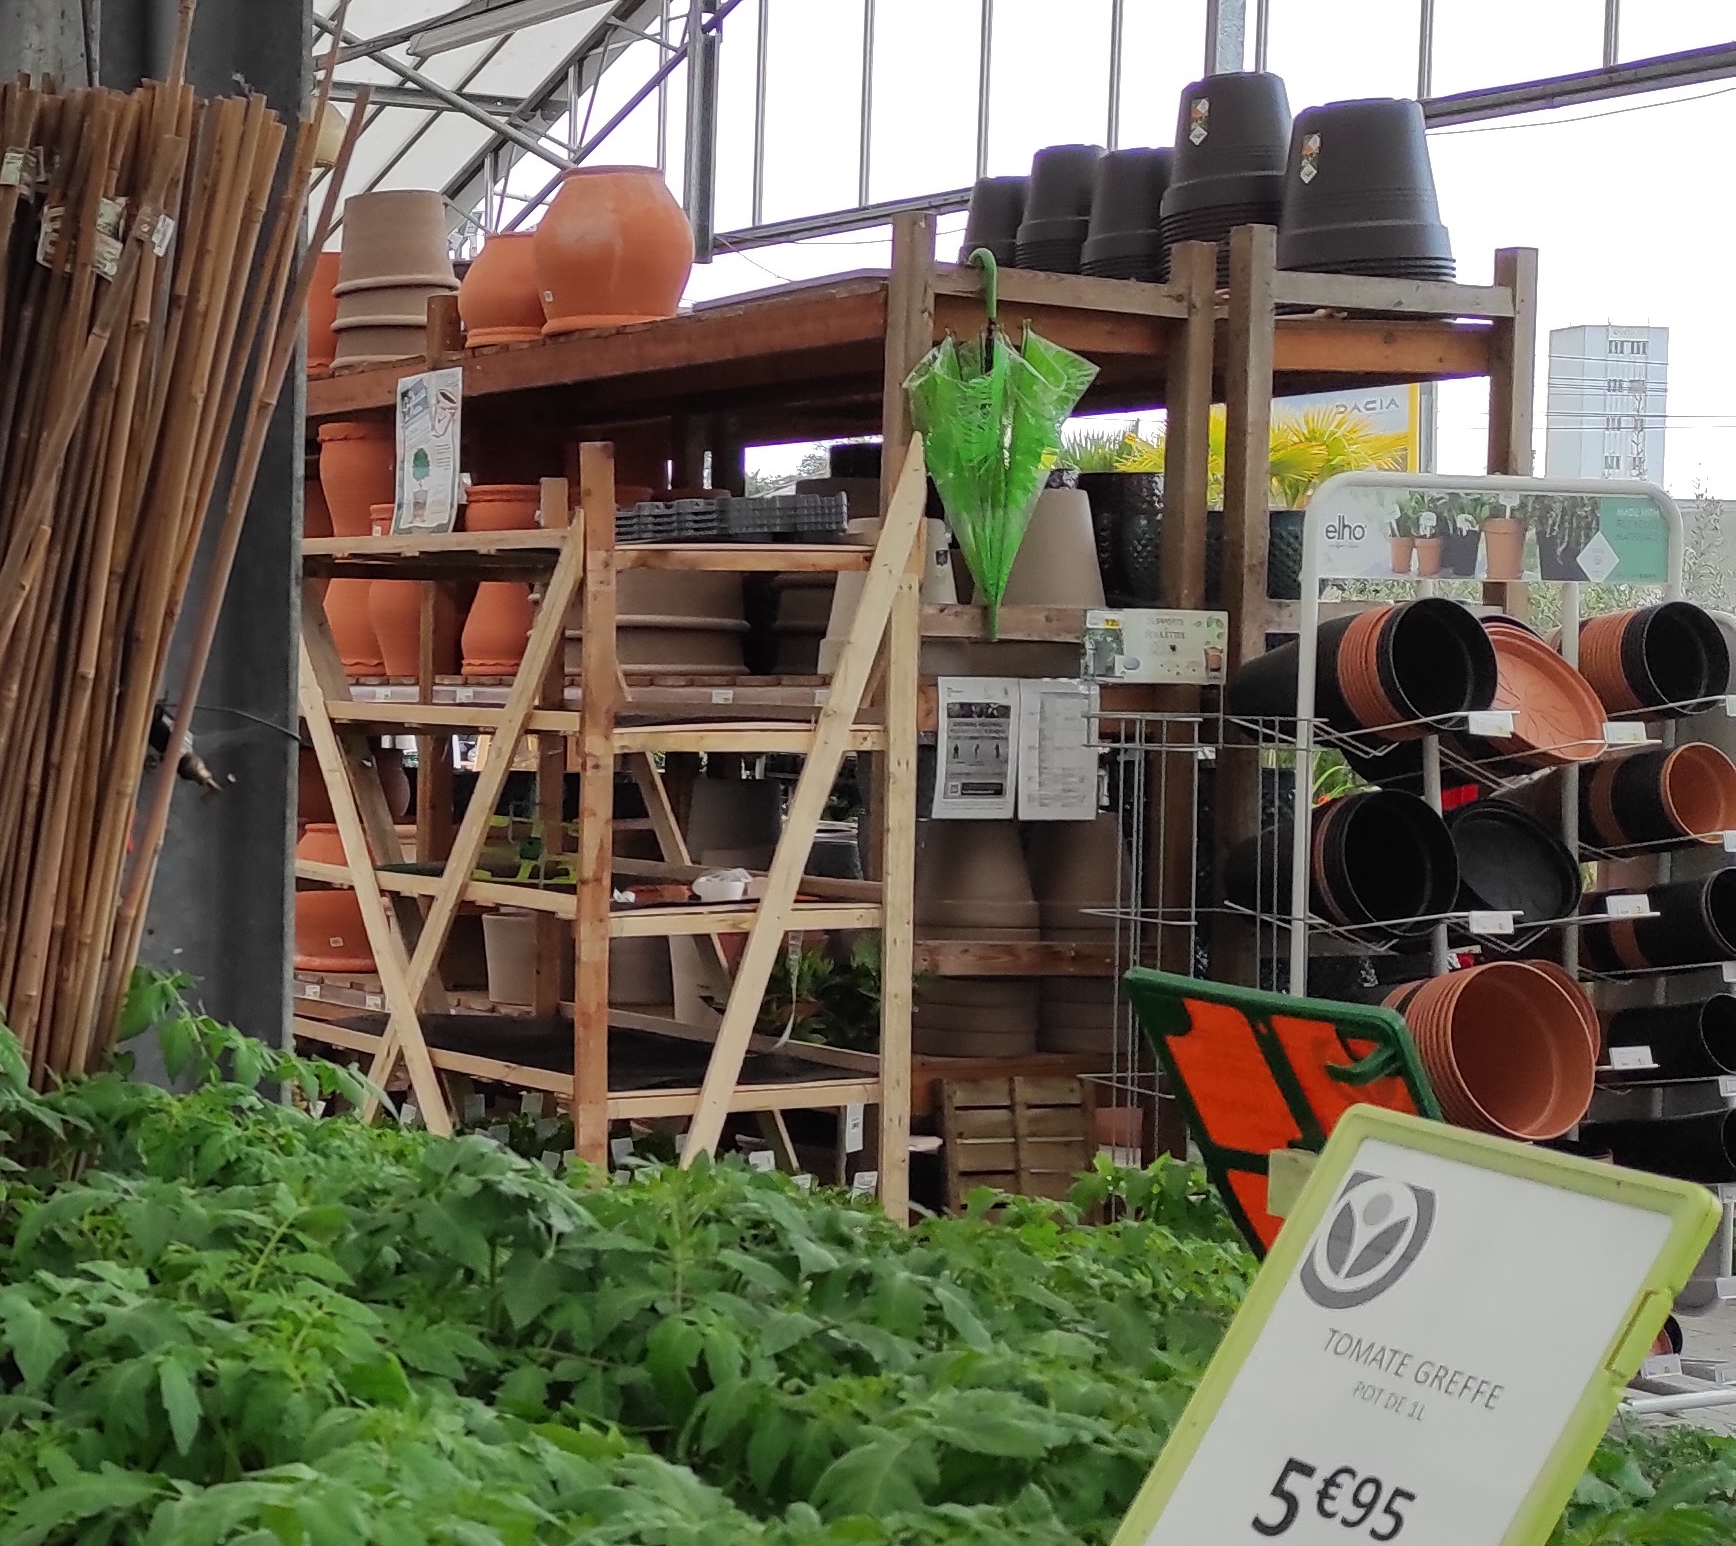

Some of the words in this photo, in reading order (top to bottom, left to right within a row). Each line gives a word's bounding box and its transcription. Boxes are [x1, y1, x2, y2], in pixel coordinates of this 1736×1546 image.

[1335, 396, 1399, 415] DACIA
[1325, 515, 1365, 541] elho
[1324, 1327, 1413, 1378] TOMATE
[1414, 1360, 1504, 1410] GREFFE
[1353, 1381, 1384, 1405] POT
[1384, 1392, 1407, 1413] DE
[1251, 1457, 1417, 1542] 5€95
